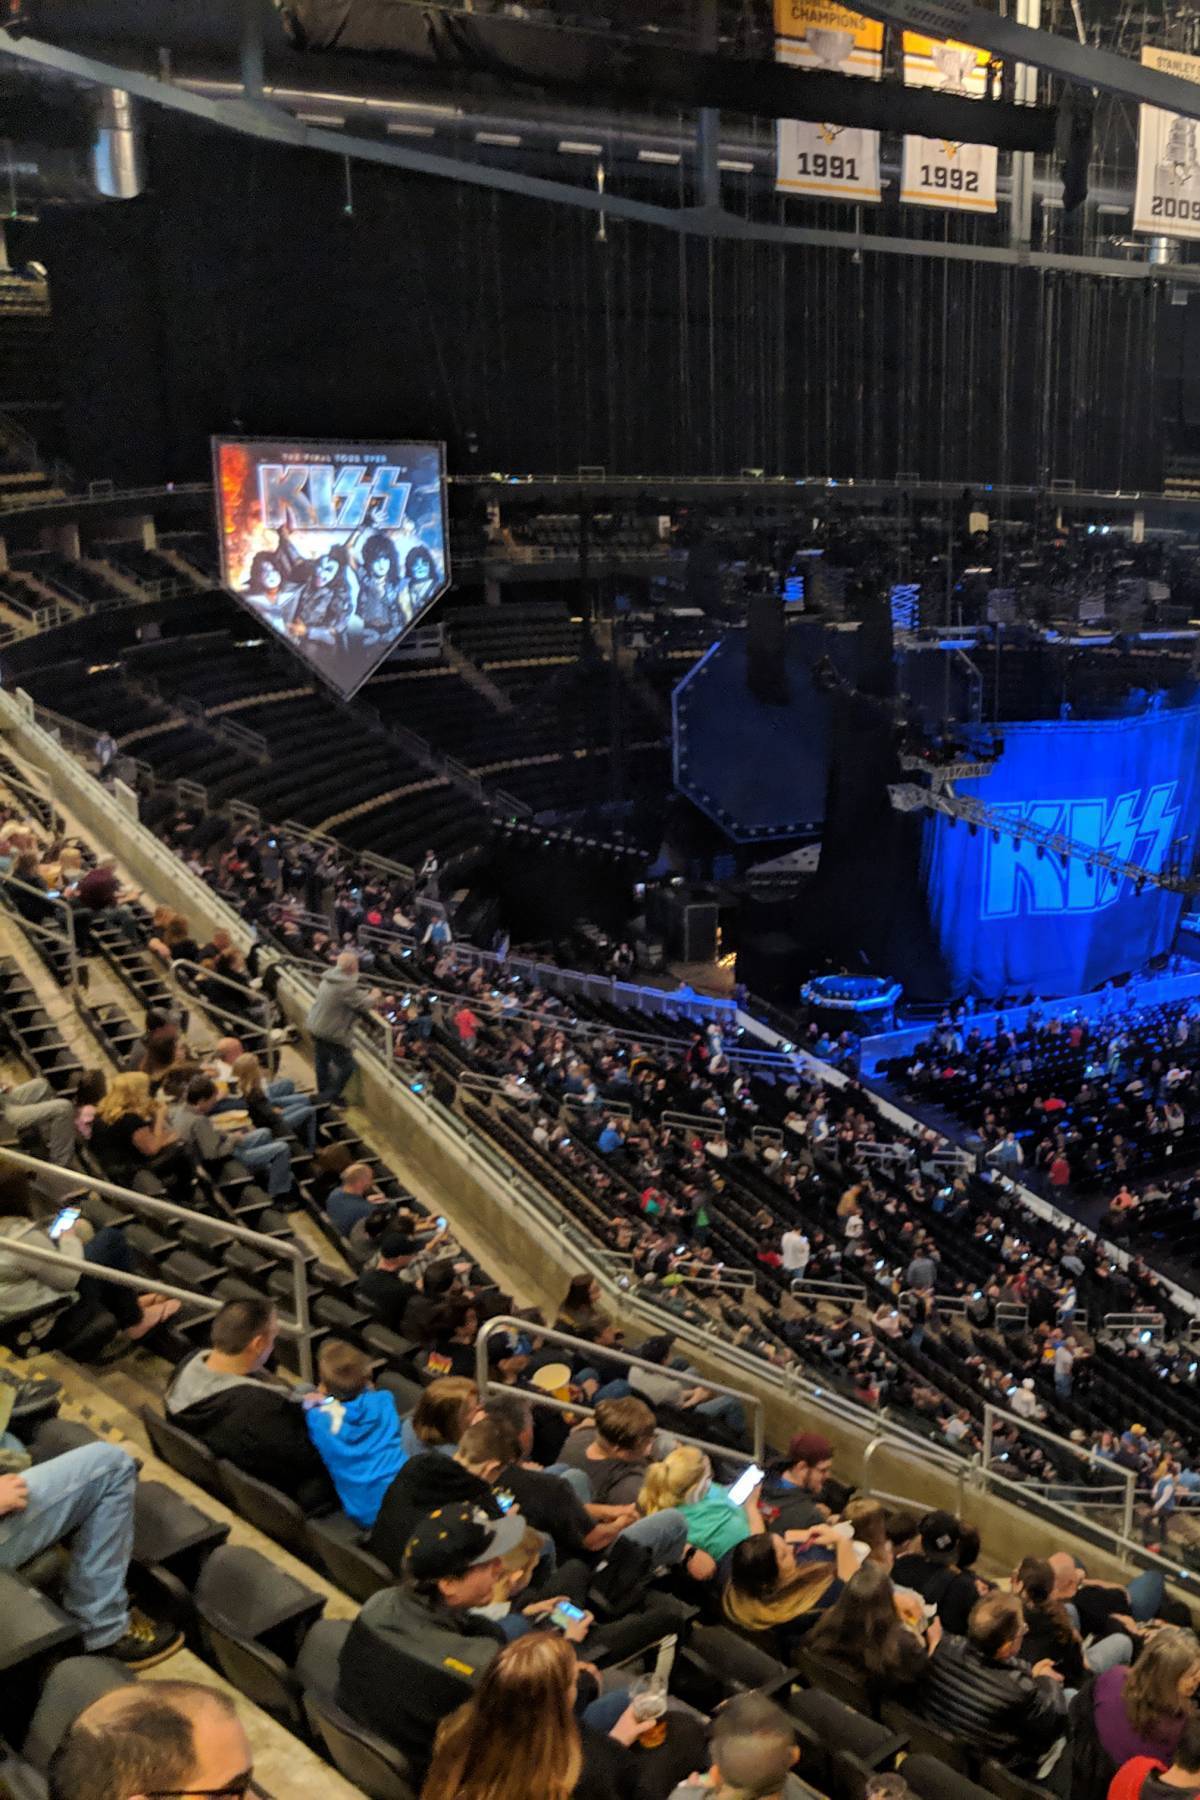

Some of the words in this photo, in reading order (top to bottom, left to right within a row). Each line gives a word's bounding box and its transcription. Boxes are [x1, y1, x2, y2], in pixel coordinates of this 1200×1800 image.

[792, 7, 866, 30] CHAMPIONS
[1157, 56, 1196, 74] STANLEY
[797, 152, 860, 181] 1991
[920, 165, 979, 192] 1992
[258, 465, 412, 530] KISS
[980, 780, 1182, 921] KISS
